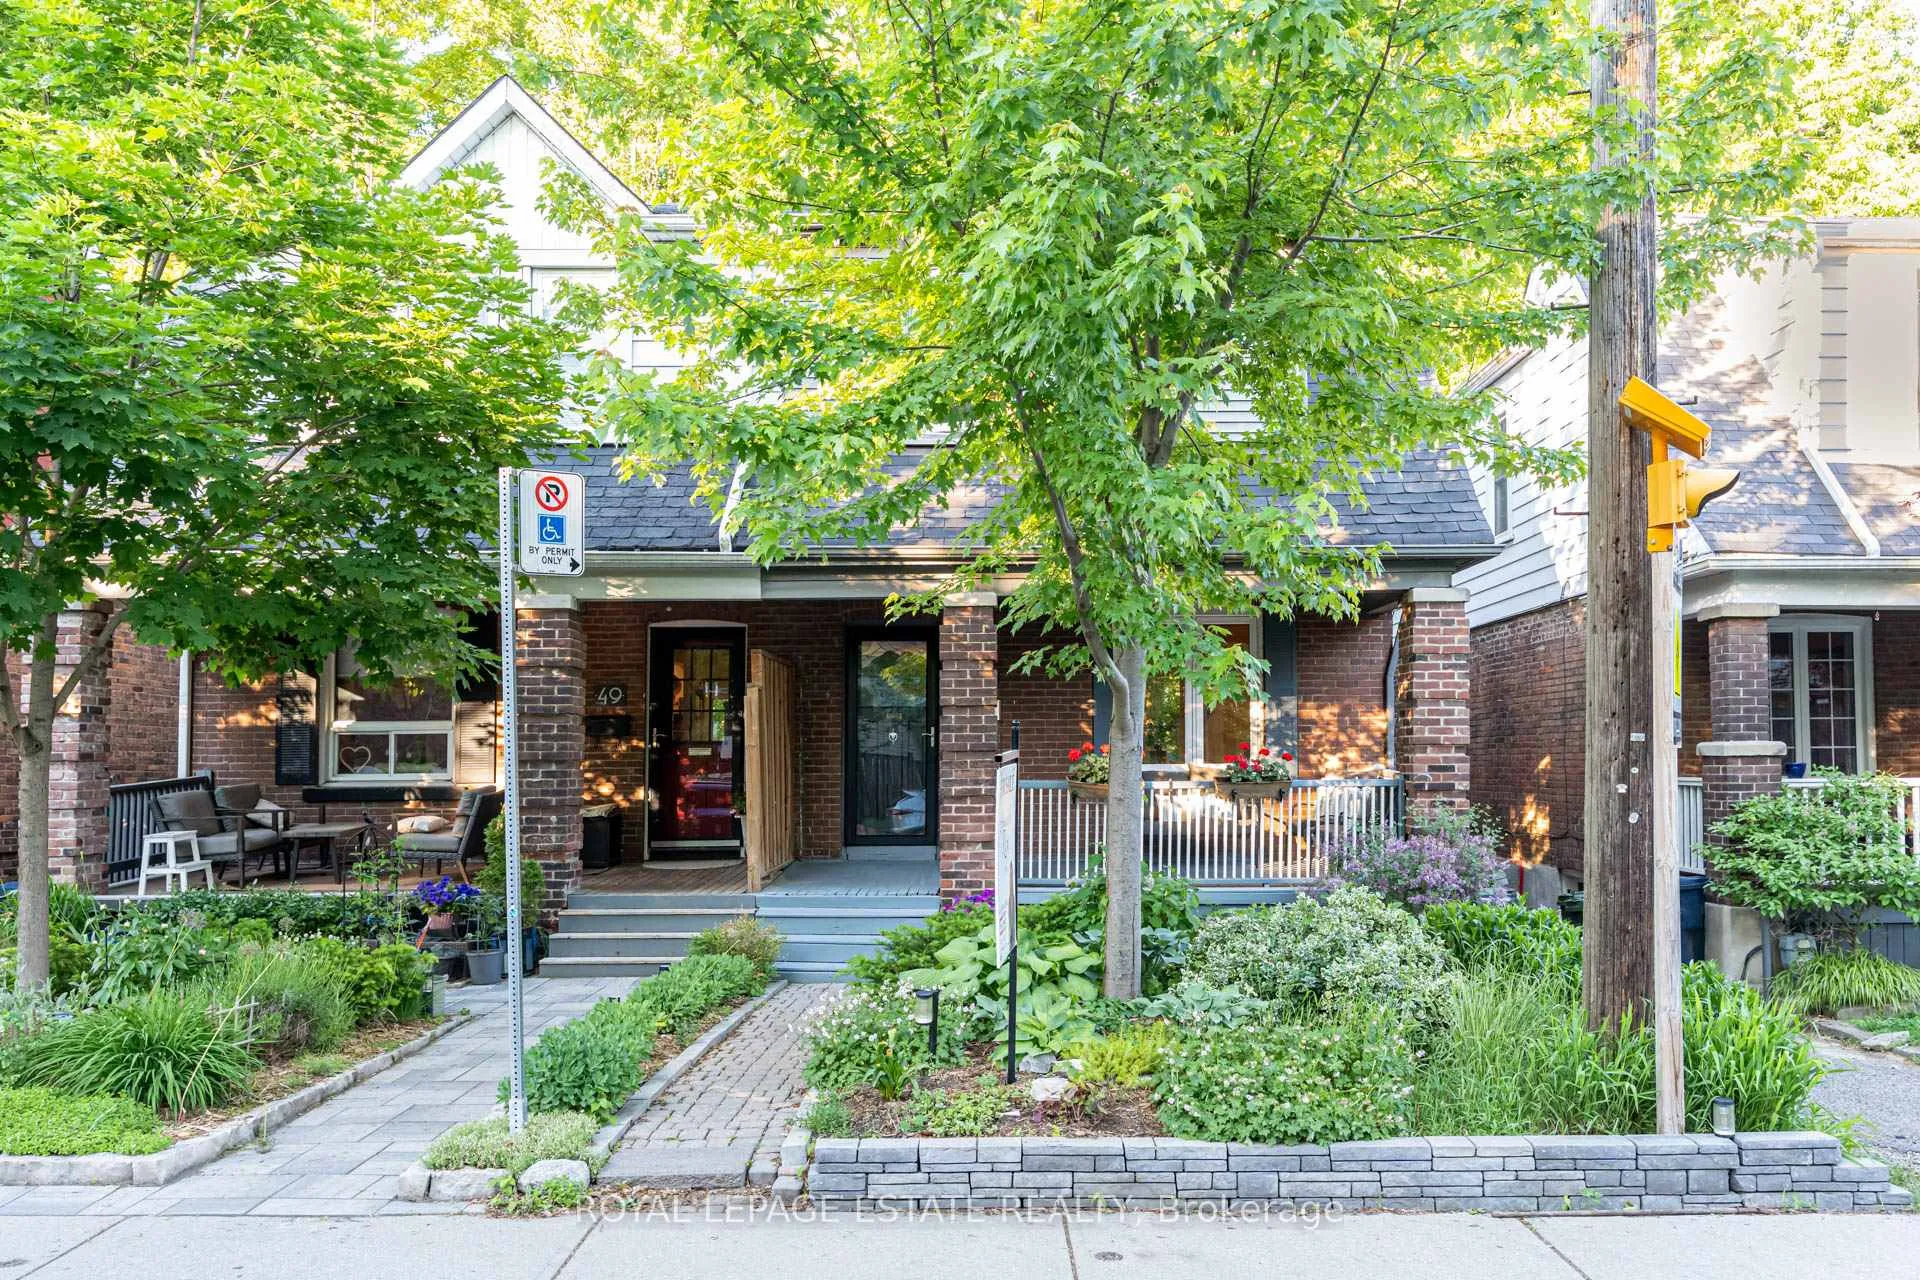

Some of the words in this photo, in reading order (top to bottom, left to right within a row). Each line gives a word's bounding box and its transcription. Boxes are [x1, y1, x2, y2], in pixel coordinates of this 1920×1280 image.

[528, 545, 540, 554] BY
[545, 547, 576, 557] PERMIT
[541, 555, 563, 565] ONLY
[597, 687, 623, 705] 49
